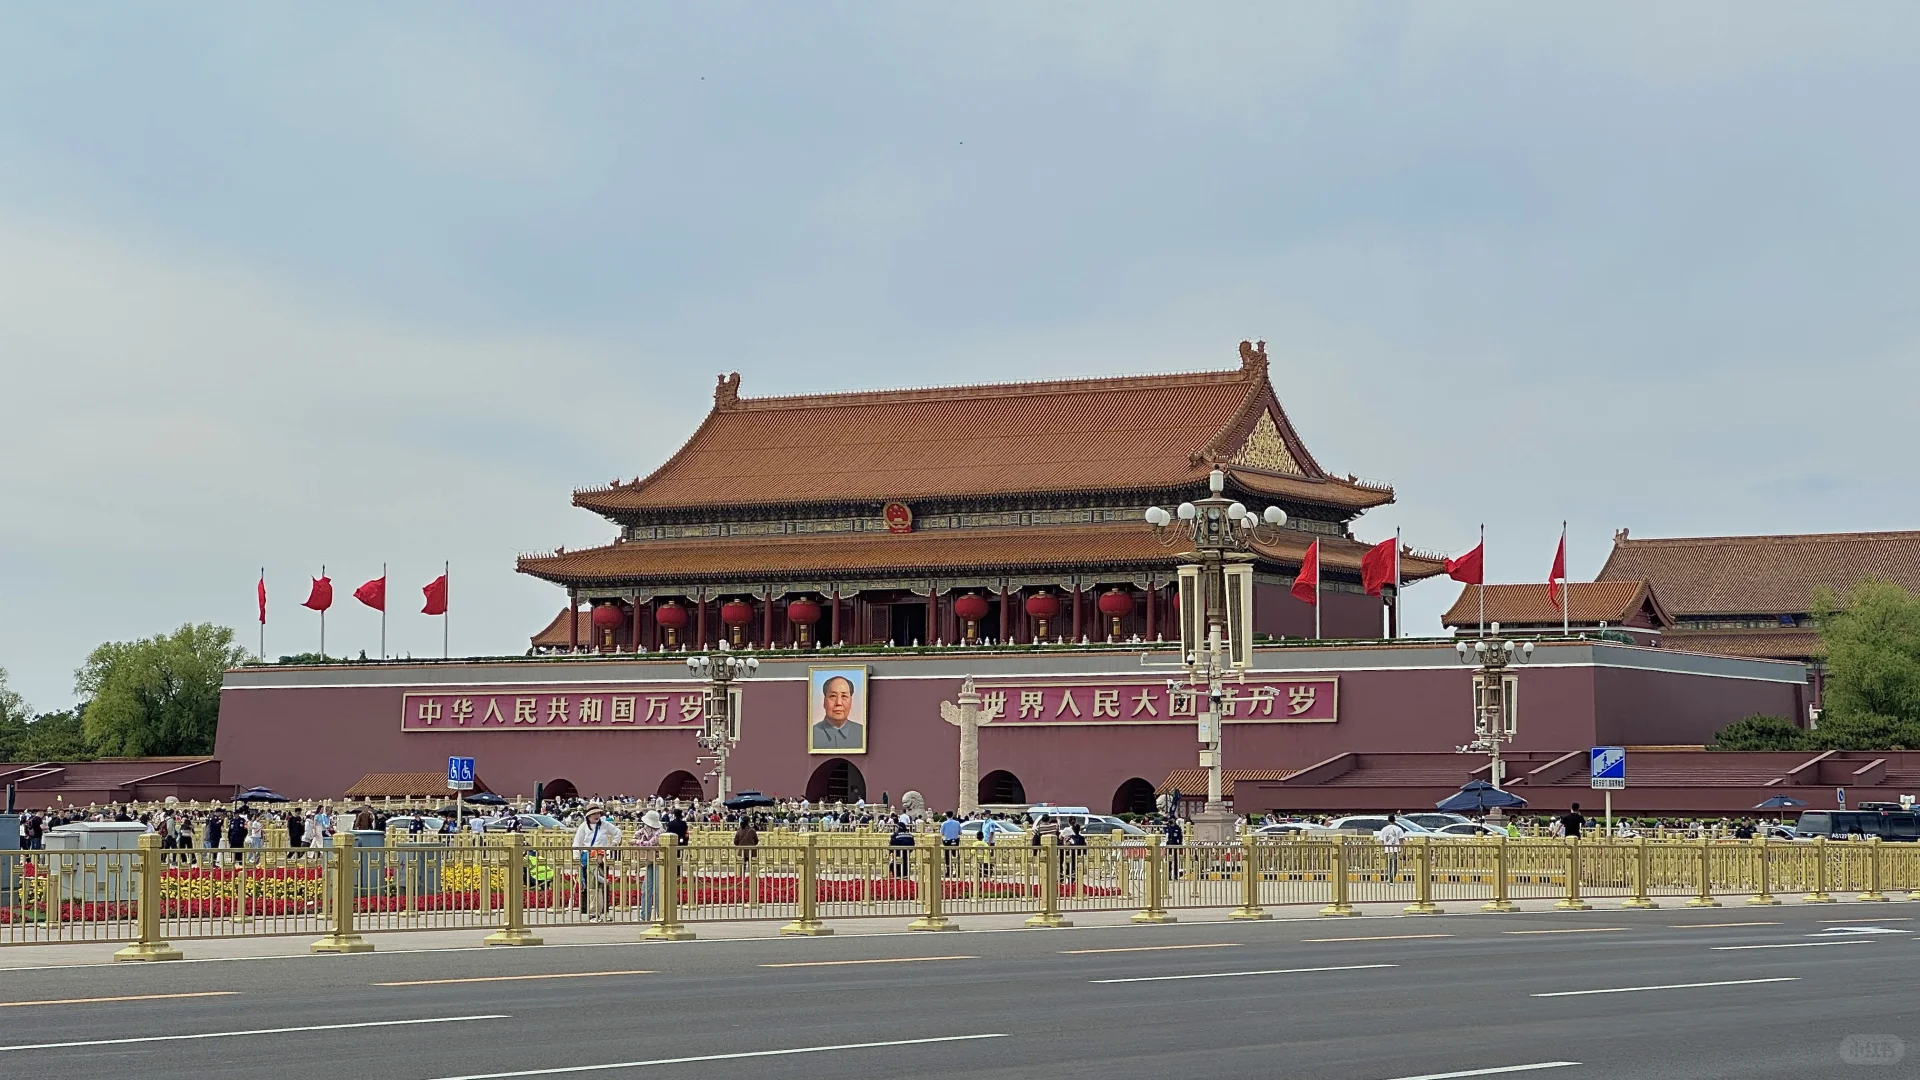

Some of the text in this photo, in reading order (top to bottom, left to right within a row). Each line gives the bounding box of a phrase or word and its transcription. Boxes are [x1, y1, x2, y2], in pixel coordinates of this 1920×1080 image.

[418, 696, 703, 725] 中华人民共和国万岁
